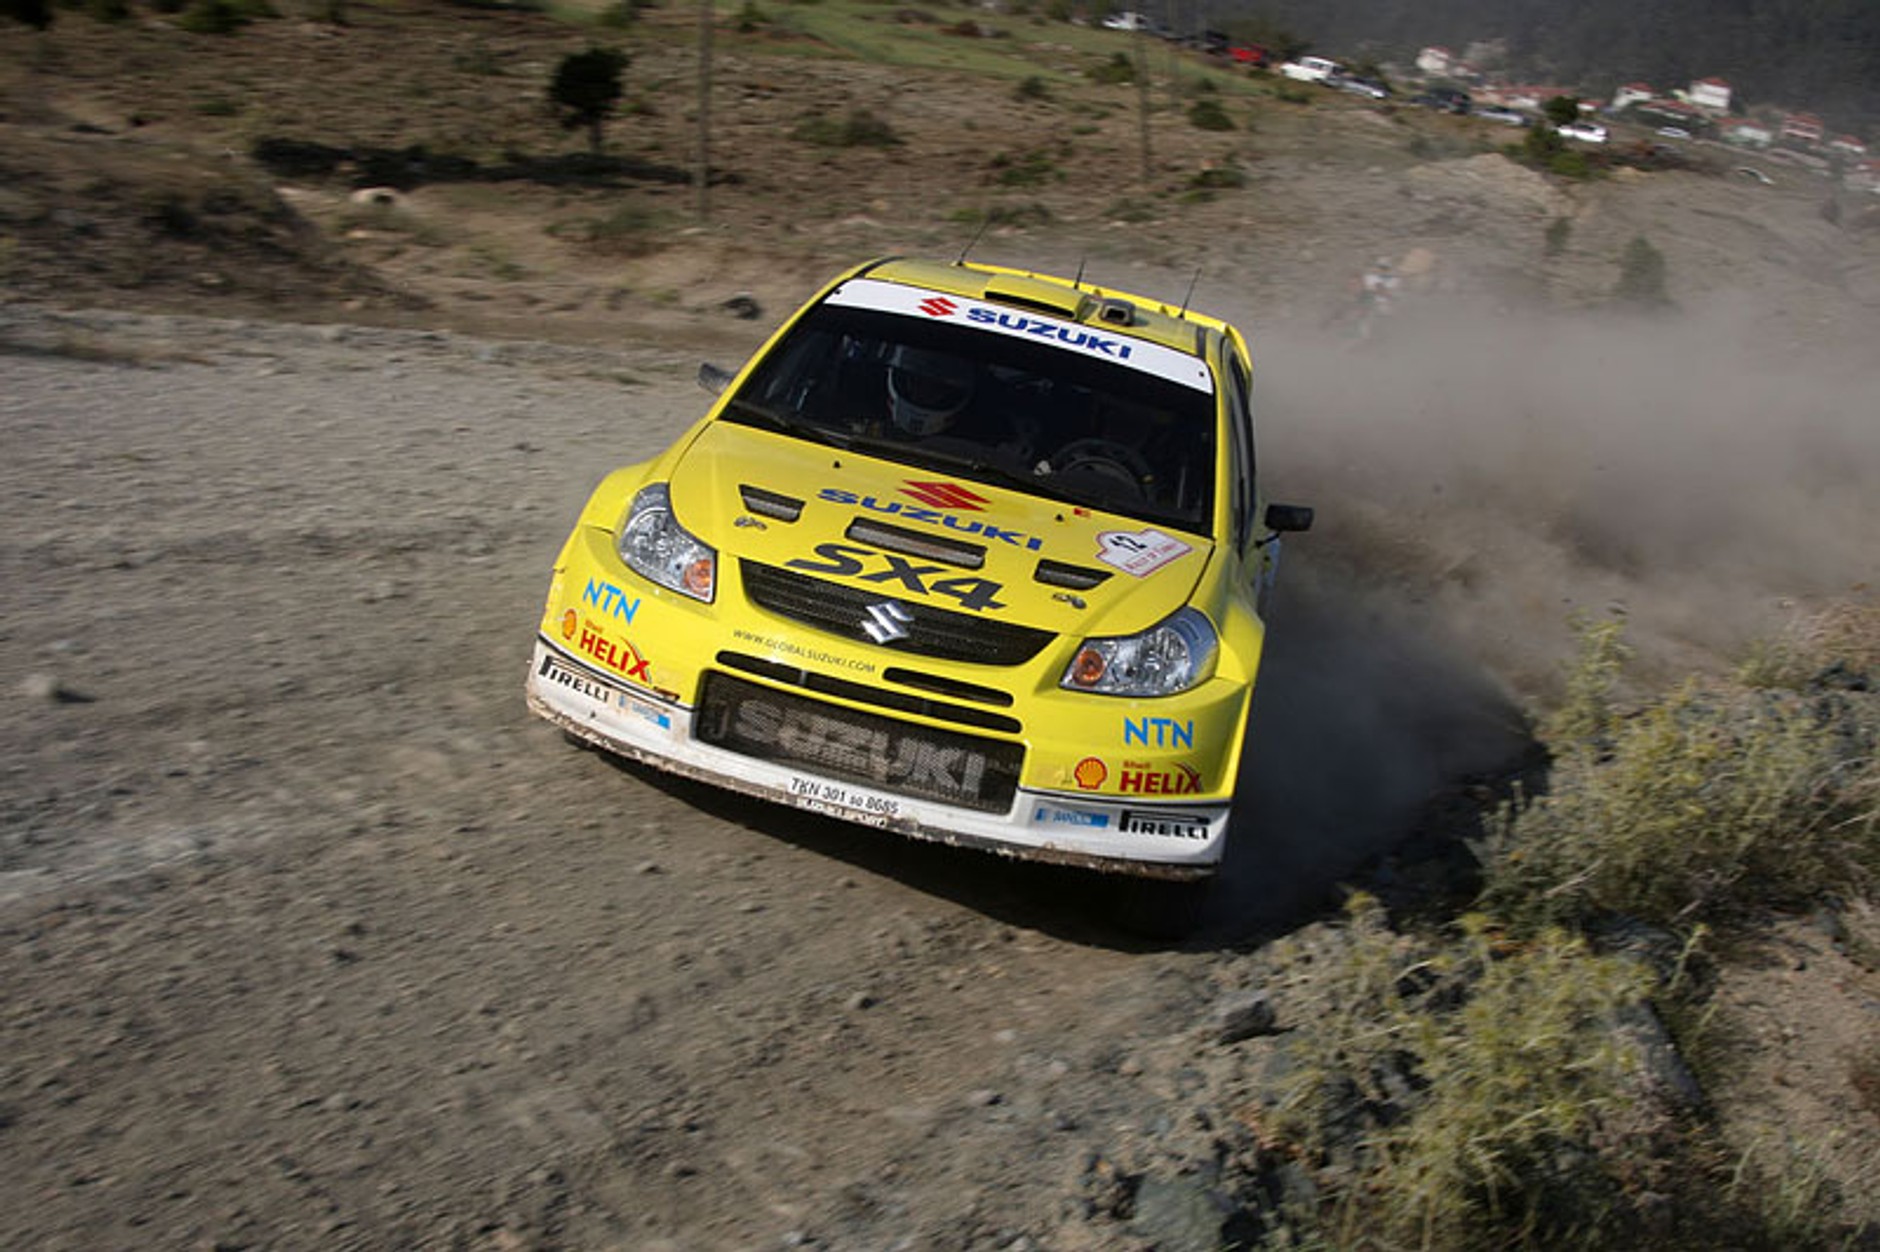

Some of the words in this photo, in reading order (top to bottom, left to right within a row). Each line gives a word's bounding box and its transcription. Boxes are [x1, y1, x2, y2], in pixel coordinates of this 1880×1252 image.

[967, 307, 1132, 359] SUZUKI
[817, 488, 1043, 551] SUZUKI
[1108, 535, 1148, 553] 12
[583, 577, 641, 625] NTN
[784, 543, 1007, 612] SX4
[538, 655, 613, 703] PIRELLI
[579, 628, 651, 682] HELIX
[1124, 716, 1194, 749] NTN
[1119, 764, 1203, 795] HELIX
[1118, 809, 1211, 840] PIRELLI
